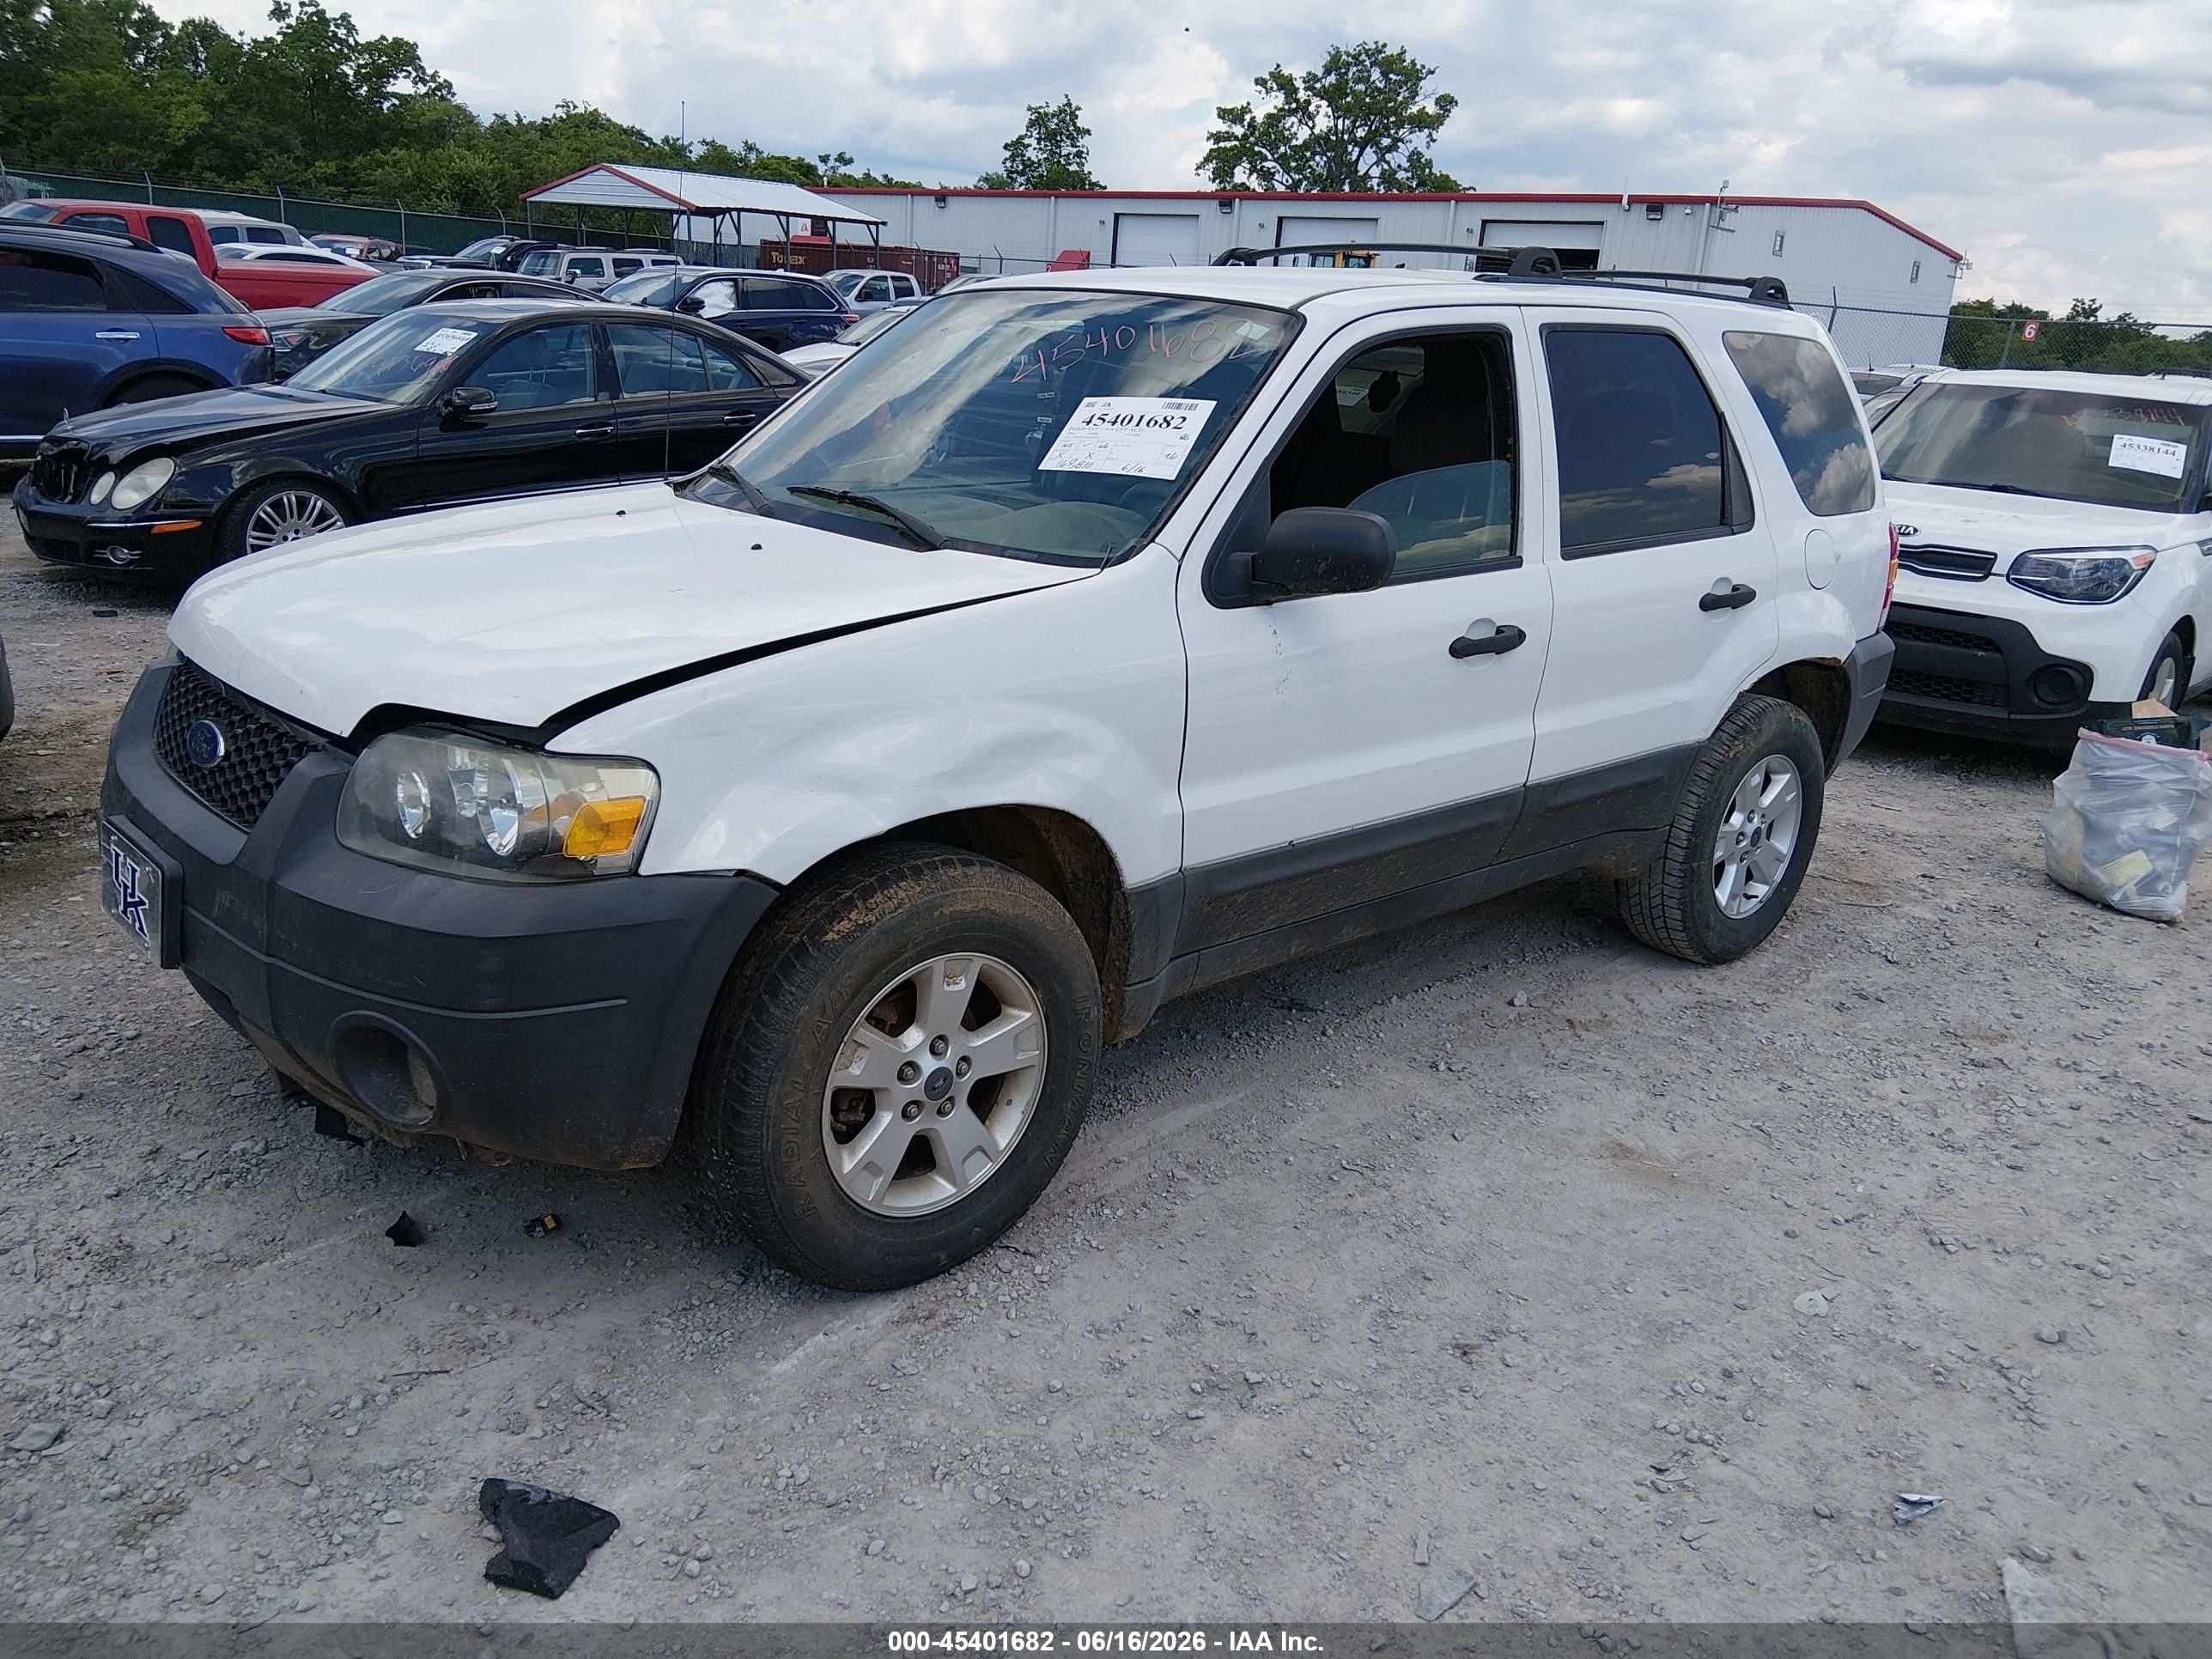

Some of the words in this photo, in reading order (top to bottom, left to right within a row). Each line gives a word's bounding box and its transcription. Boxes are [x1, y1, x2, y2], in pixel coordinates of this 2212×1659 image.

[2025, 323, 2036, 338] 6
[1011, 319, 1260, 384] 45401682
[1081, 412, 1188, 430] 45401682
[2119, 442, 2177, 458] 45338144
[778, 1066, 818, 1221] RADIAL
